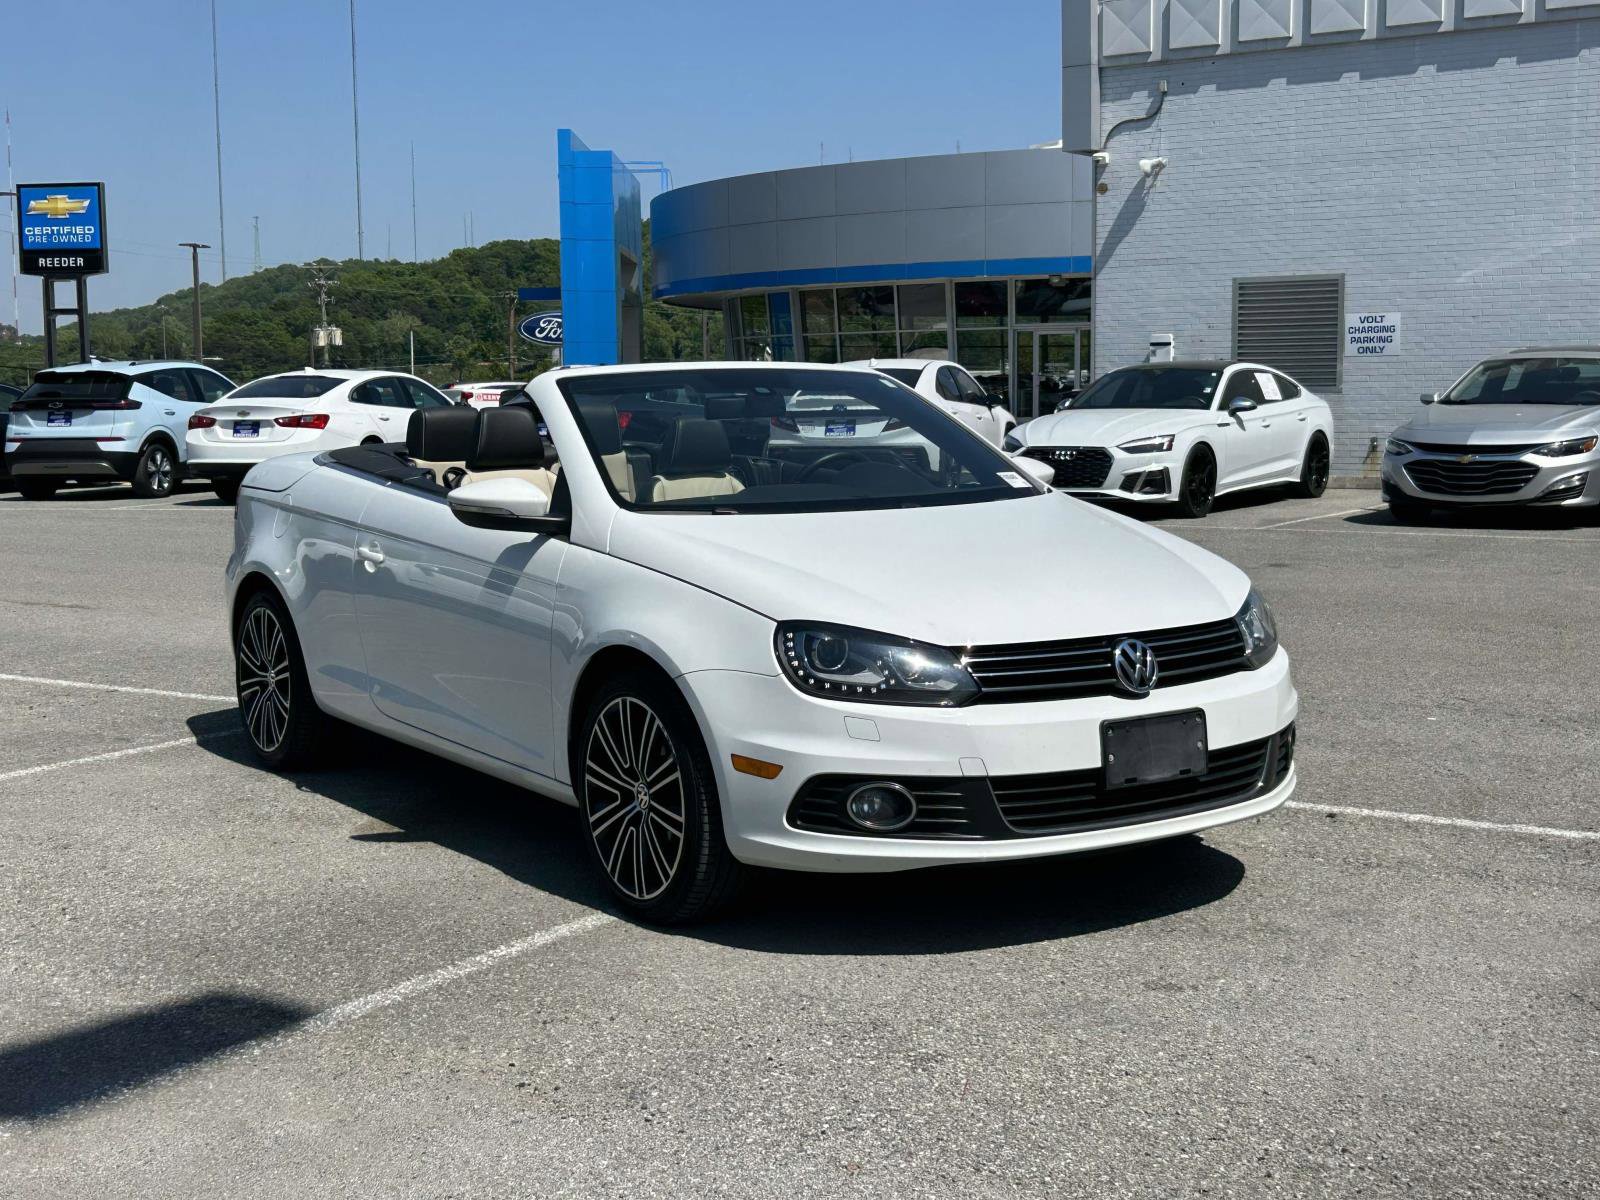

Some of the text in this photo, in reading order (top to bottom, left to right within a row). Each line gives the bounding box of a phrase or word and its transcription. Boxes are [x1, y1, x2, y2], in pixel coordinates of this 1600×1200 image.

[25, 225, 95, 235] CERTIFIED
[28, 234, 92, 243] PRE-OWNED
[38, 257, 84, 267] REEDER
[1359, 315, 1386, 324] VOLT
[534, 317, 562, 338] Fo
[1348, 325, 1396, 335] CHARGING
[1350, 335, 1393, 344] PARKING
[1357, 345, 1386, 355] ONLY
